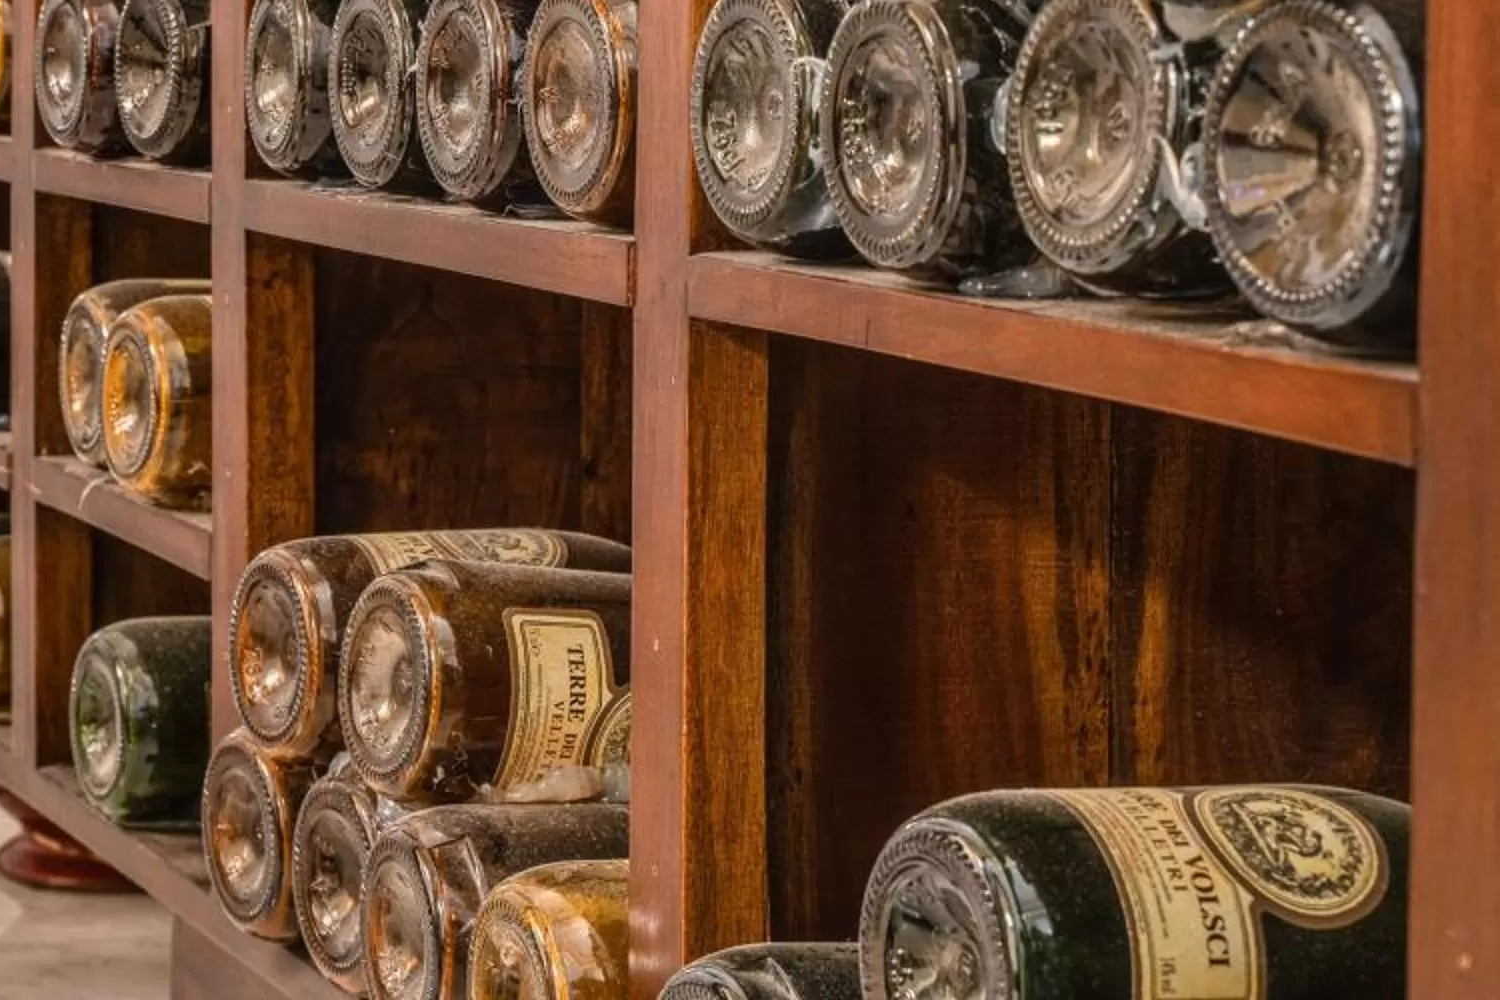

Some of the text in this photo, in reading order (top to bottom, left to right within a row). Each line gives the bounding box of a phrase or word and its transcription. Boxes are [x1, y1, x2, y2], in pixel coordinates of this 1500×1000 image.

[567, 643, 587, 723] TERRE
[560, 733, 578, 759] DEI
[1159, 820, 1190, 847] DEI
[1184, 855, 1231, 967] VOLSCI
